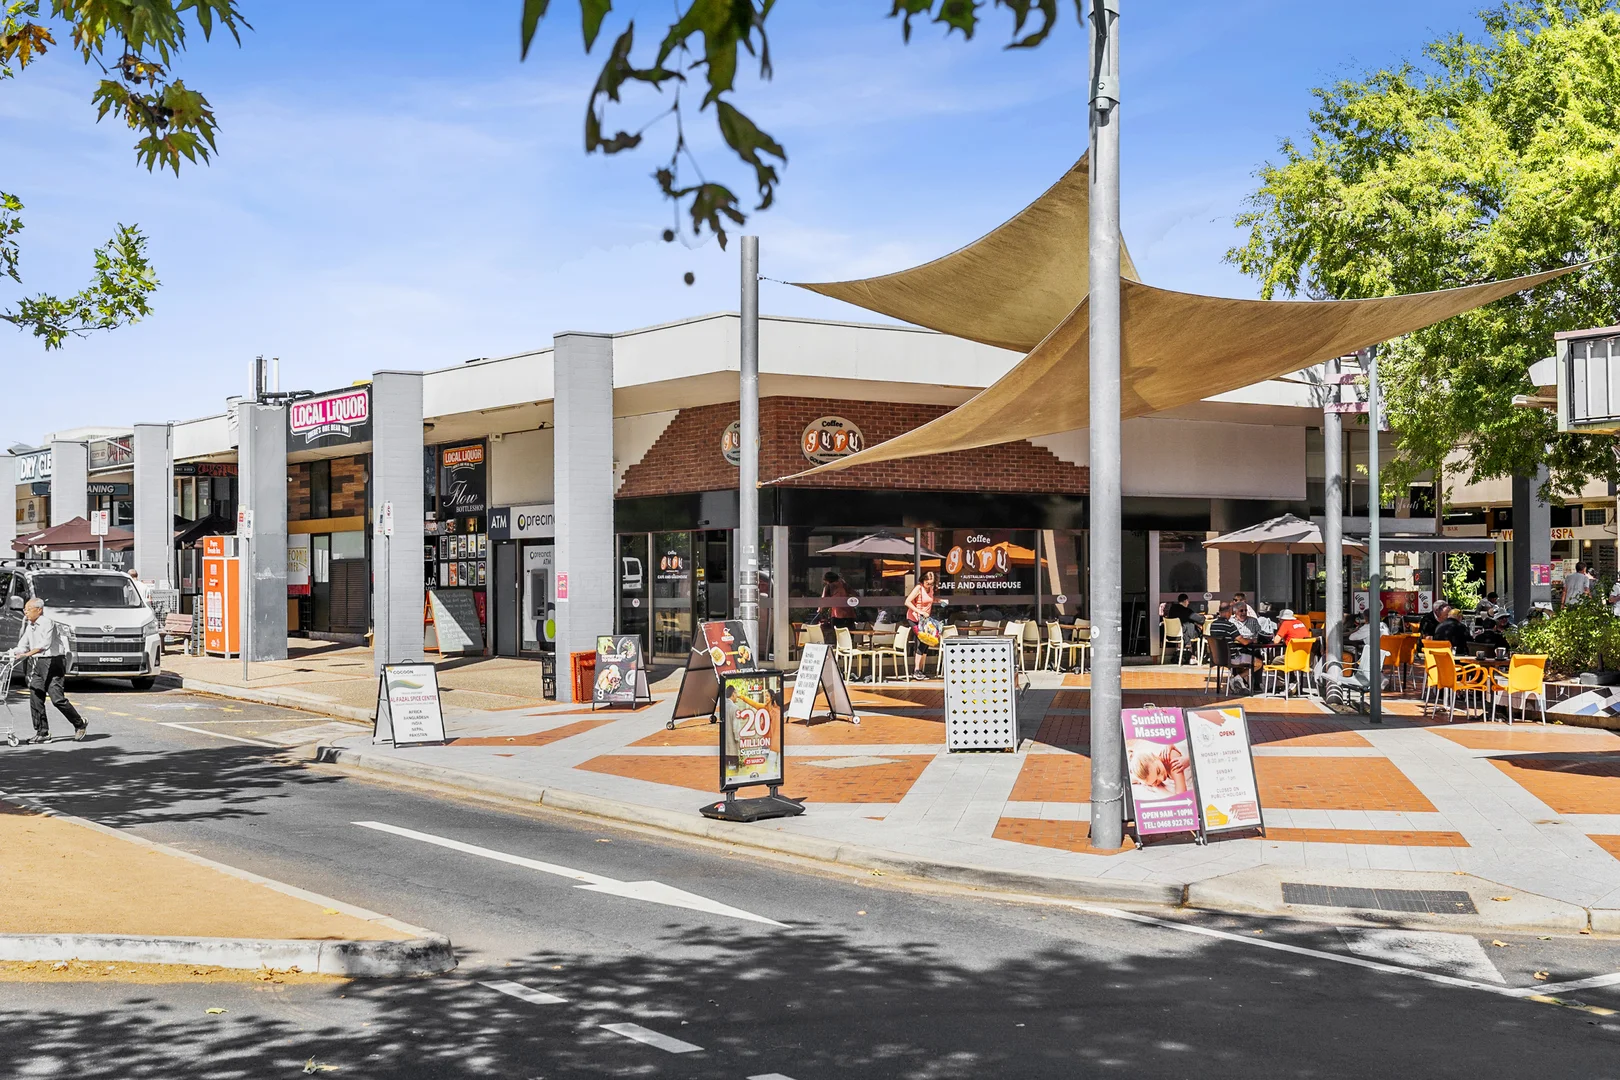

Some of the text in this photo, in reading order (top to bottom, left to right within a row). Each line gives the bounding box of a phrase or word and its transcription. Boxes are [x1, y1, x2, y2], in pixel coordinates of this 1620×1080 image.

[293, 403, 326, 427] LOCAL
[821, 420, 843, 428] Coffee
[806, 430, 859, 453] guru
[445, 451, 461, 464] LOCAL
[20, 456, 37, 480] DRY
[443, 479, 478, 507] Flow
[456, 504, 484, 513] BOTTLESHOP
[490, 515, 507, 529] ATM
[966, 534, 991, 544] Coffee
[948, 547, 1008, 573] guru
[976, 581, 1022, 589] BAKEHOUSE
[736, 708, 770, 737] $20
[1131, 713, 1176, 726] Sunshine
[1134, 727, 1177, 739] Massage
[740, 738, 770, 748] MILLION
[740, 748, 770, 757] Superdraw
[1142, 811, 1159, 820] OPEN
[1160, 809, 1173, 818] 9AM
[1176, 808, 1194, 818] 10PM
[1143, 818, 1194, 830] TEL: 0468 922 762
